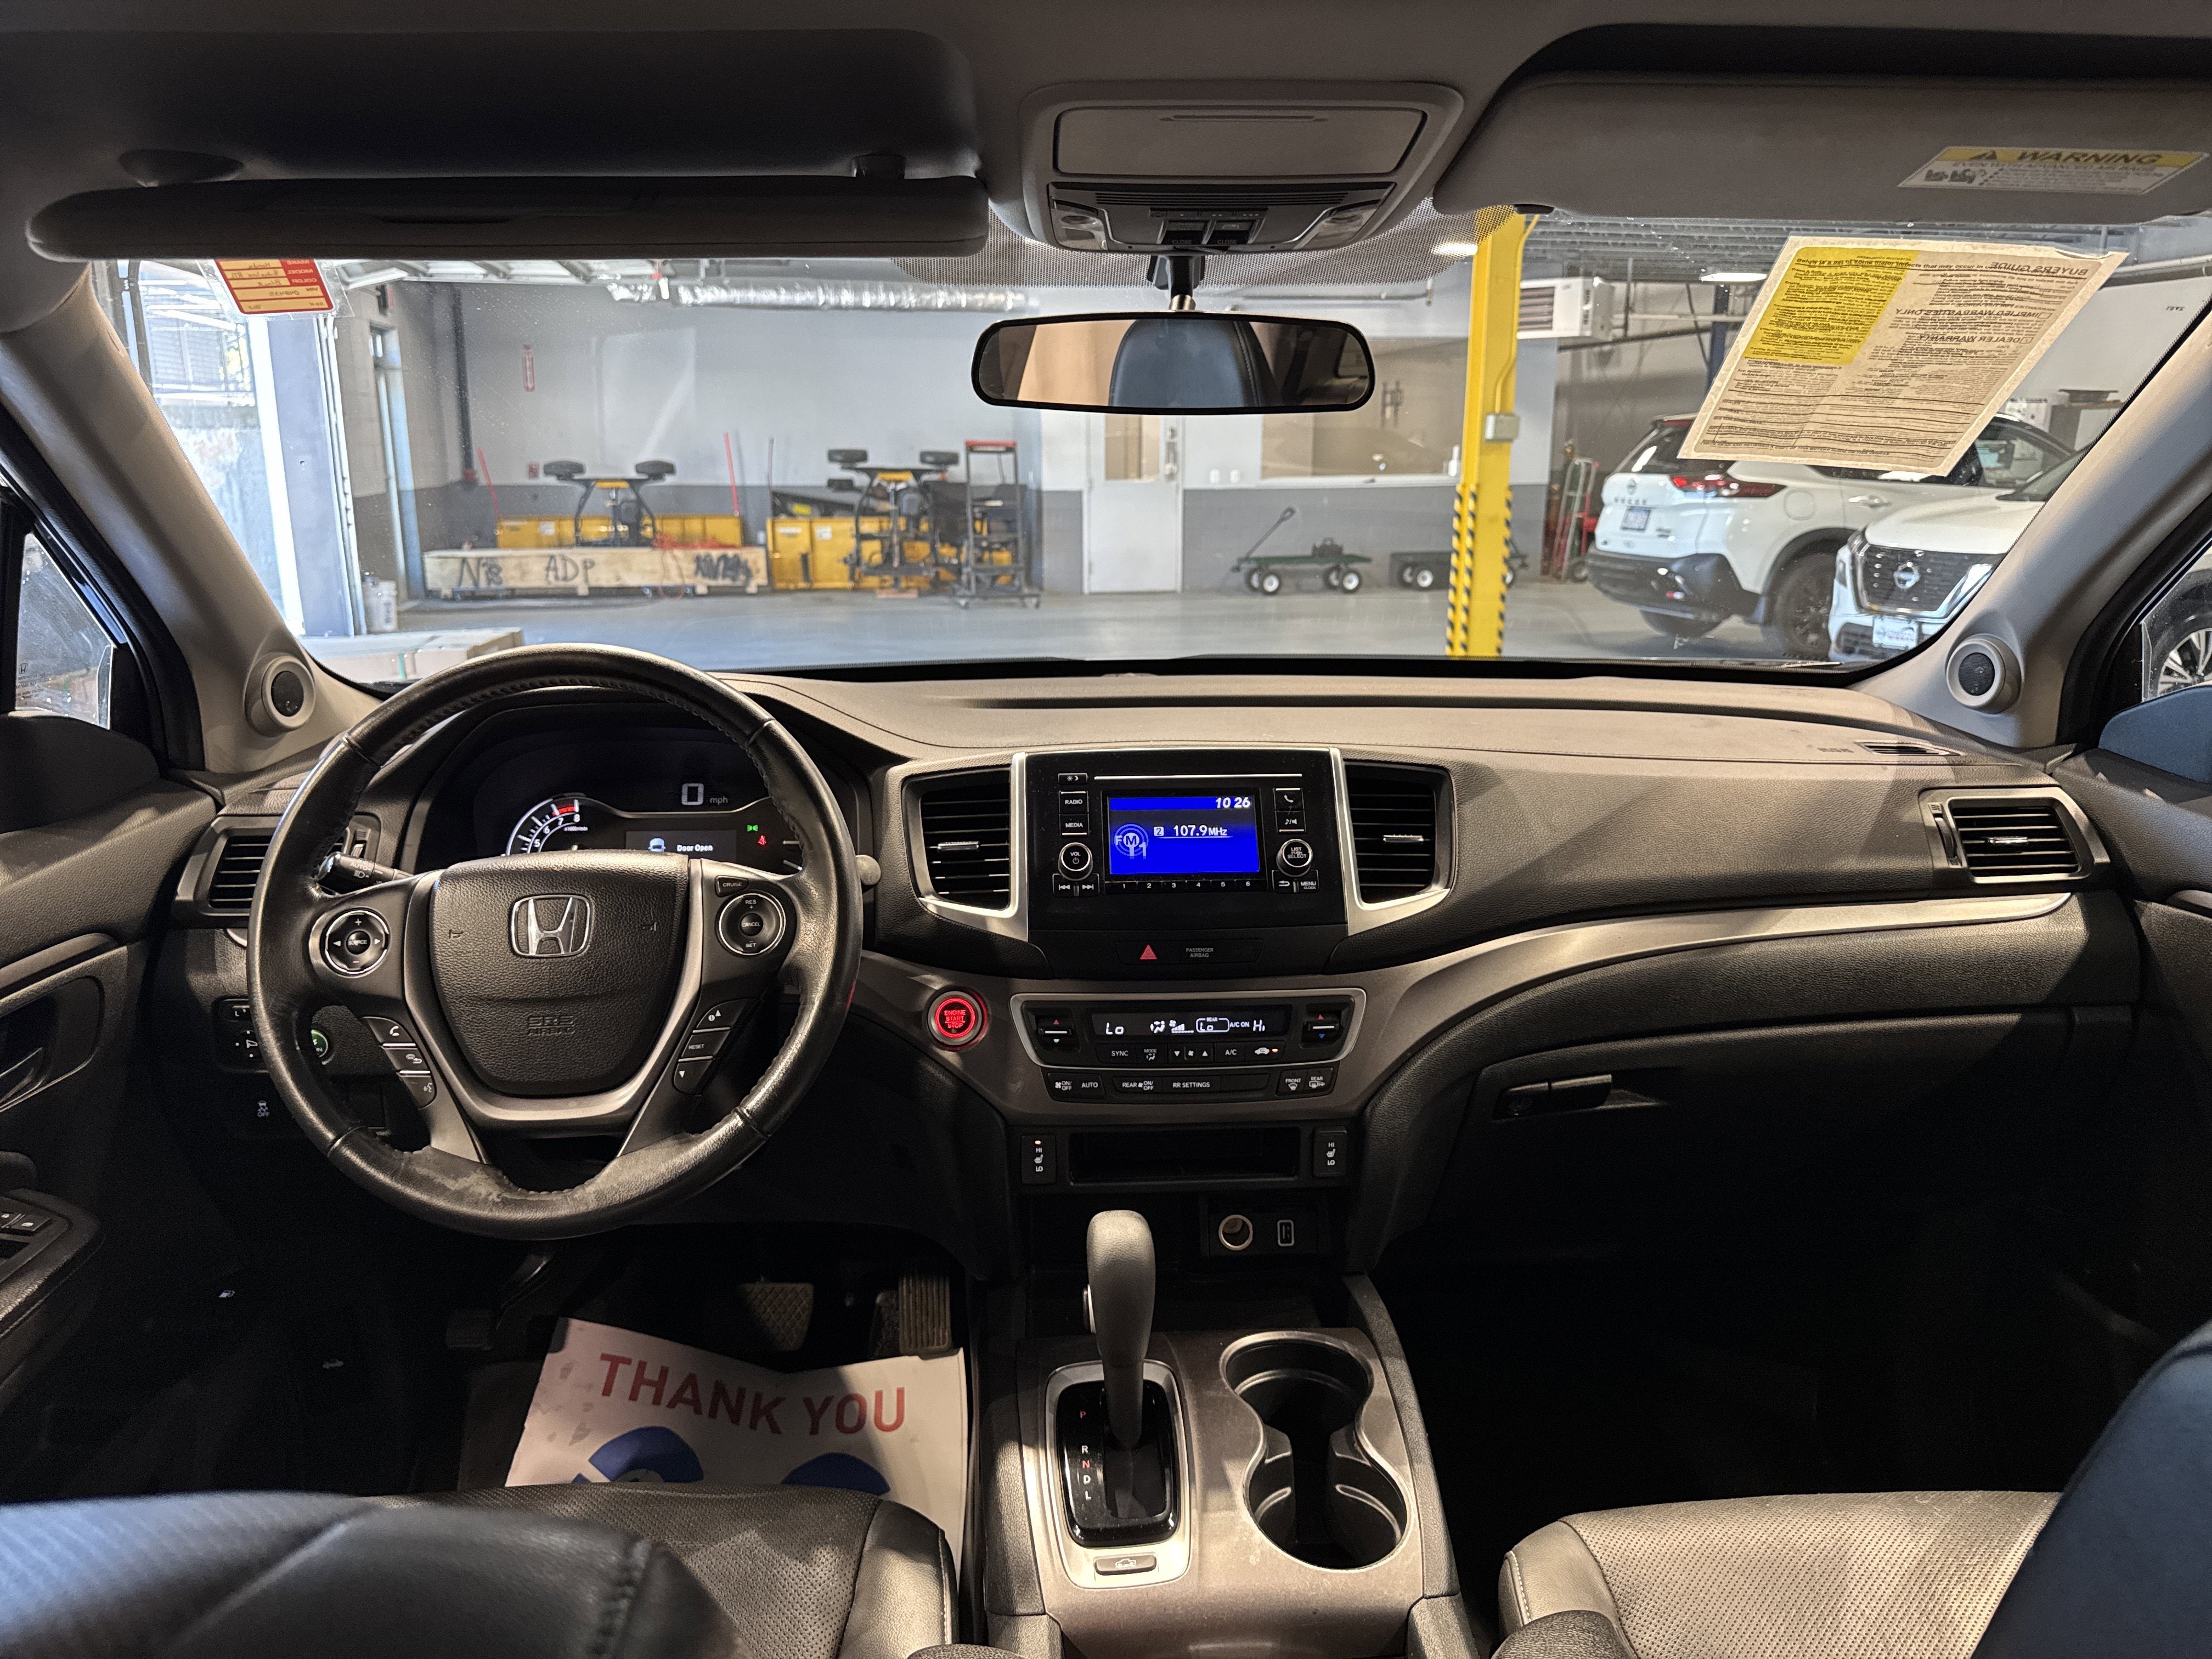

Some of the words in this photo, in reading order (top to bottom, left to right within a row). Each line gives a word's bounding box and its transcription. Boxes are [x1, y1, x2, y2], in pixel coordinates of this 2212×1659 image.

[2018, 151, 2162, 163] WARNING
[681, 783, 704, 805] 0
[710, 795, 728, 805] mph
[557, 817, 563, 826] 7
[573, 814, 580, 822] 8
[543, 826, 550, 834] 6
[1155, 827, 1162, 836] 2
[533, 839, 540, 848] 5
[695, 844, 713, 852] Open
[350, 862, 368, 871] AUTO
[527, 1015, 574, 1026] SRS
[1105, 1022, 1124, 1035] Lo
[600, 1352, 785, 1435] THANK
[803, 1387, 905, 1435] YOU
[1081, 1445, 1088, 1453] R
[1082, 1460, 1090, 1469] N
[1083, 1475, 1091, 1485] D
[1085, 1491, 1092, 1500] L
